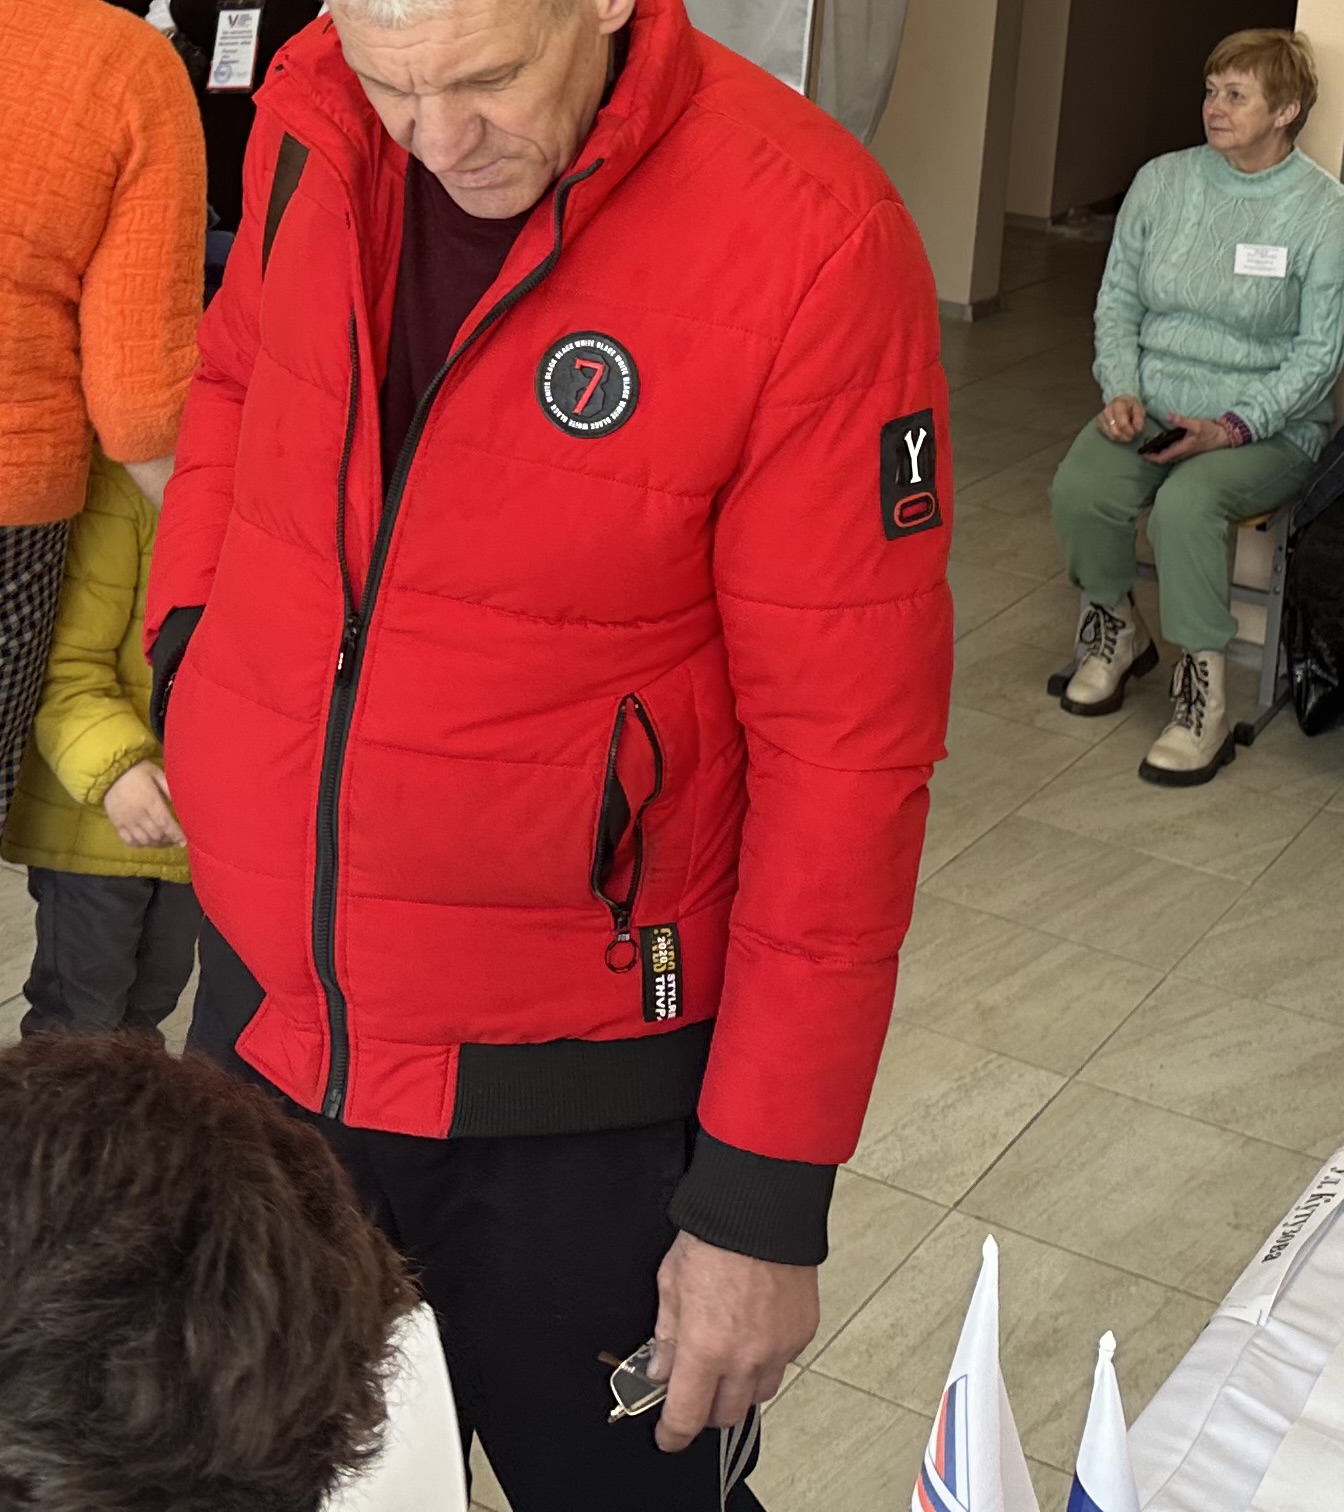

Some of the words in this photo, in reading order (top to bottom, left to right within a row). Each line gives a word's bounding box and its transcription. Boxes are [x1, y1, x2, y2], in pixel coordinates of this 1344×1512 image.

[572, 357, 605, 415] 7
[904, 427, 927, 484] Y
[656, 936, 668, 964] 2020
